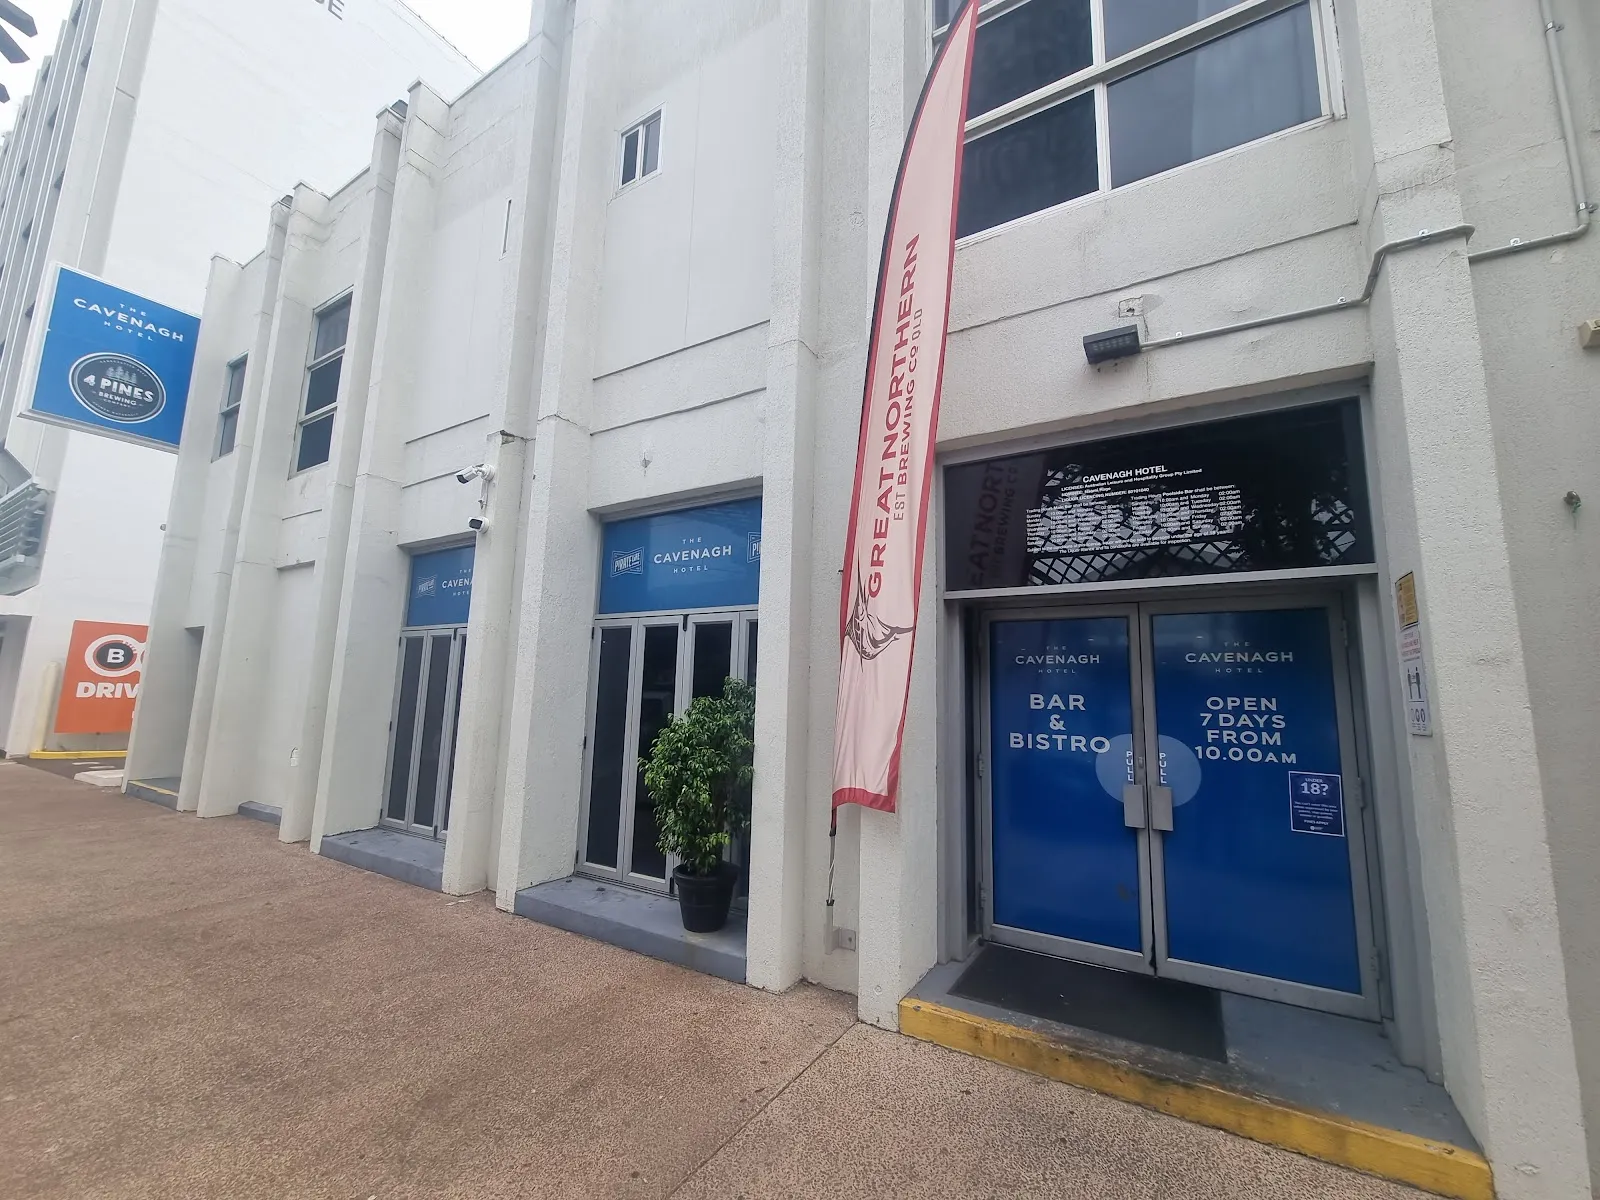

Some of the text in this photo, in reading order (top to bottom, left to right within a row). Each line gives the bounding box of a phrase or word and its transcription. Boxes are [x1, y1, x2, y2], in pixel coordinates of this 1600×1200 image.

[315, 0, 345, 20] E
[73, 298, 184, 342] CAVENAGH
[119, 303, 147, 317] THE
[104, 321, 153, 341] HOTEL
[912, 308, 923, 341] QLD
[83, 374, 154, 402] 4 PINES
[98, 391, 137, 406] BREWING
[868, 234, 920, 598] GREAT NORTHERN
[898, 379, 915, 485] BREWING
[1082, 464, 1168, 484] CAVENAGH HOTEL
[894, 492, 906, 520] EST
[653, 544, 732, 564] CAVENAGH
[673, 565, 708, 573] HOTEL
[107, 648, 125, 664] B
[1015, 654, 1100, 665] CAVENAGH
[1185, 651, 1294, 663] CAVENAGH
[1029, 694, 1086, 711] BAR
[1206, 697, 1278, 711] OPEN
[1050, 714, 1066, 731] &
[1200, 713, 1287, 729] 7 DAYS
[1009, 732, 1111, 754] BISTRO
[1207, 730, 1282, 746] FROM
[1126, 751, 1134, 781] PULL
[1159, 752, 1167, 783] PULL
[1301, 782, 1328, 795] 18?
